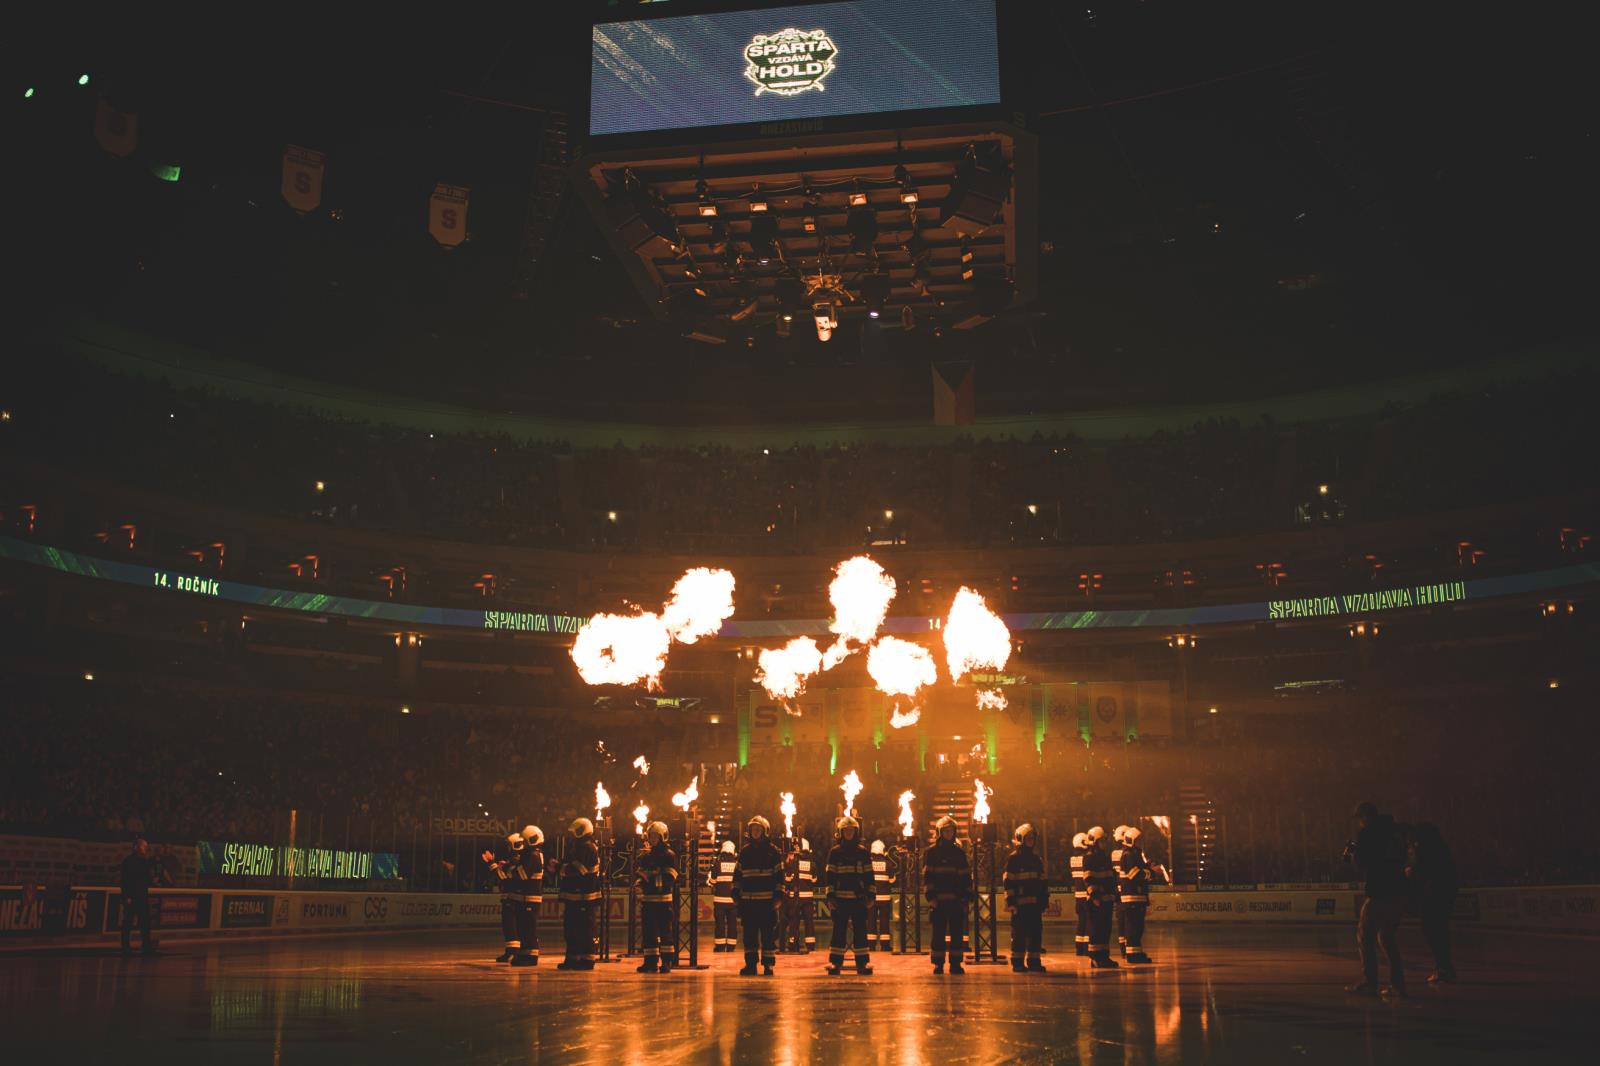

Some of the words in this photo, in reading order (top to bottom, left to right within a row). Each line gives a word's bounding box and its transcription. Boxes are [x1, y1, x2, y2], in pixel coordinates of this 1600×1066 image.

[749, 40, 832, 57] SPARTA
[760, 62, 823, 79] HOLD
[441, 208, 457, 229] S
[154, 572, 171, 587] 14.
[177, 576, 219, 596] ROČNÍK
[1269, 596, 1340, 619] SPARTA
[1416, 581, 1466, 605] HOLD
[484, 610, 549, 632] SPARTA
[754, 705, 778, 728] S
[303, 903, 349, 918] FORTUNA
